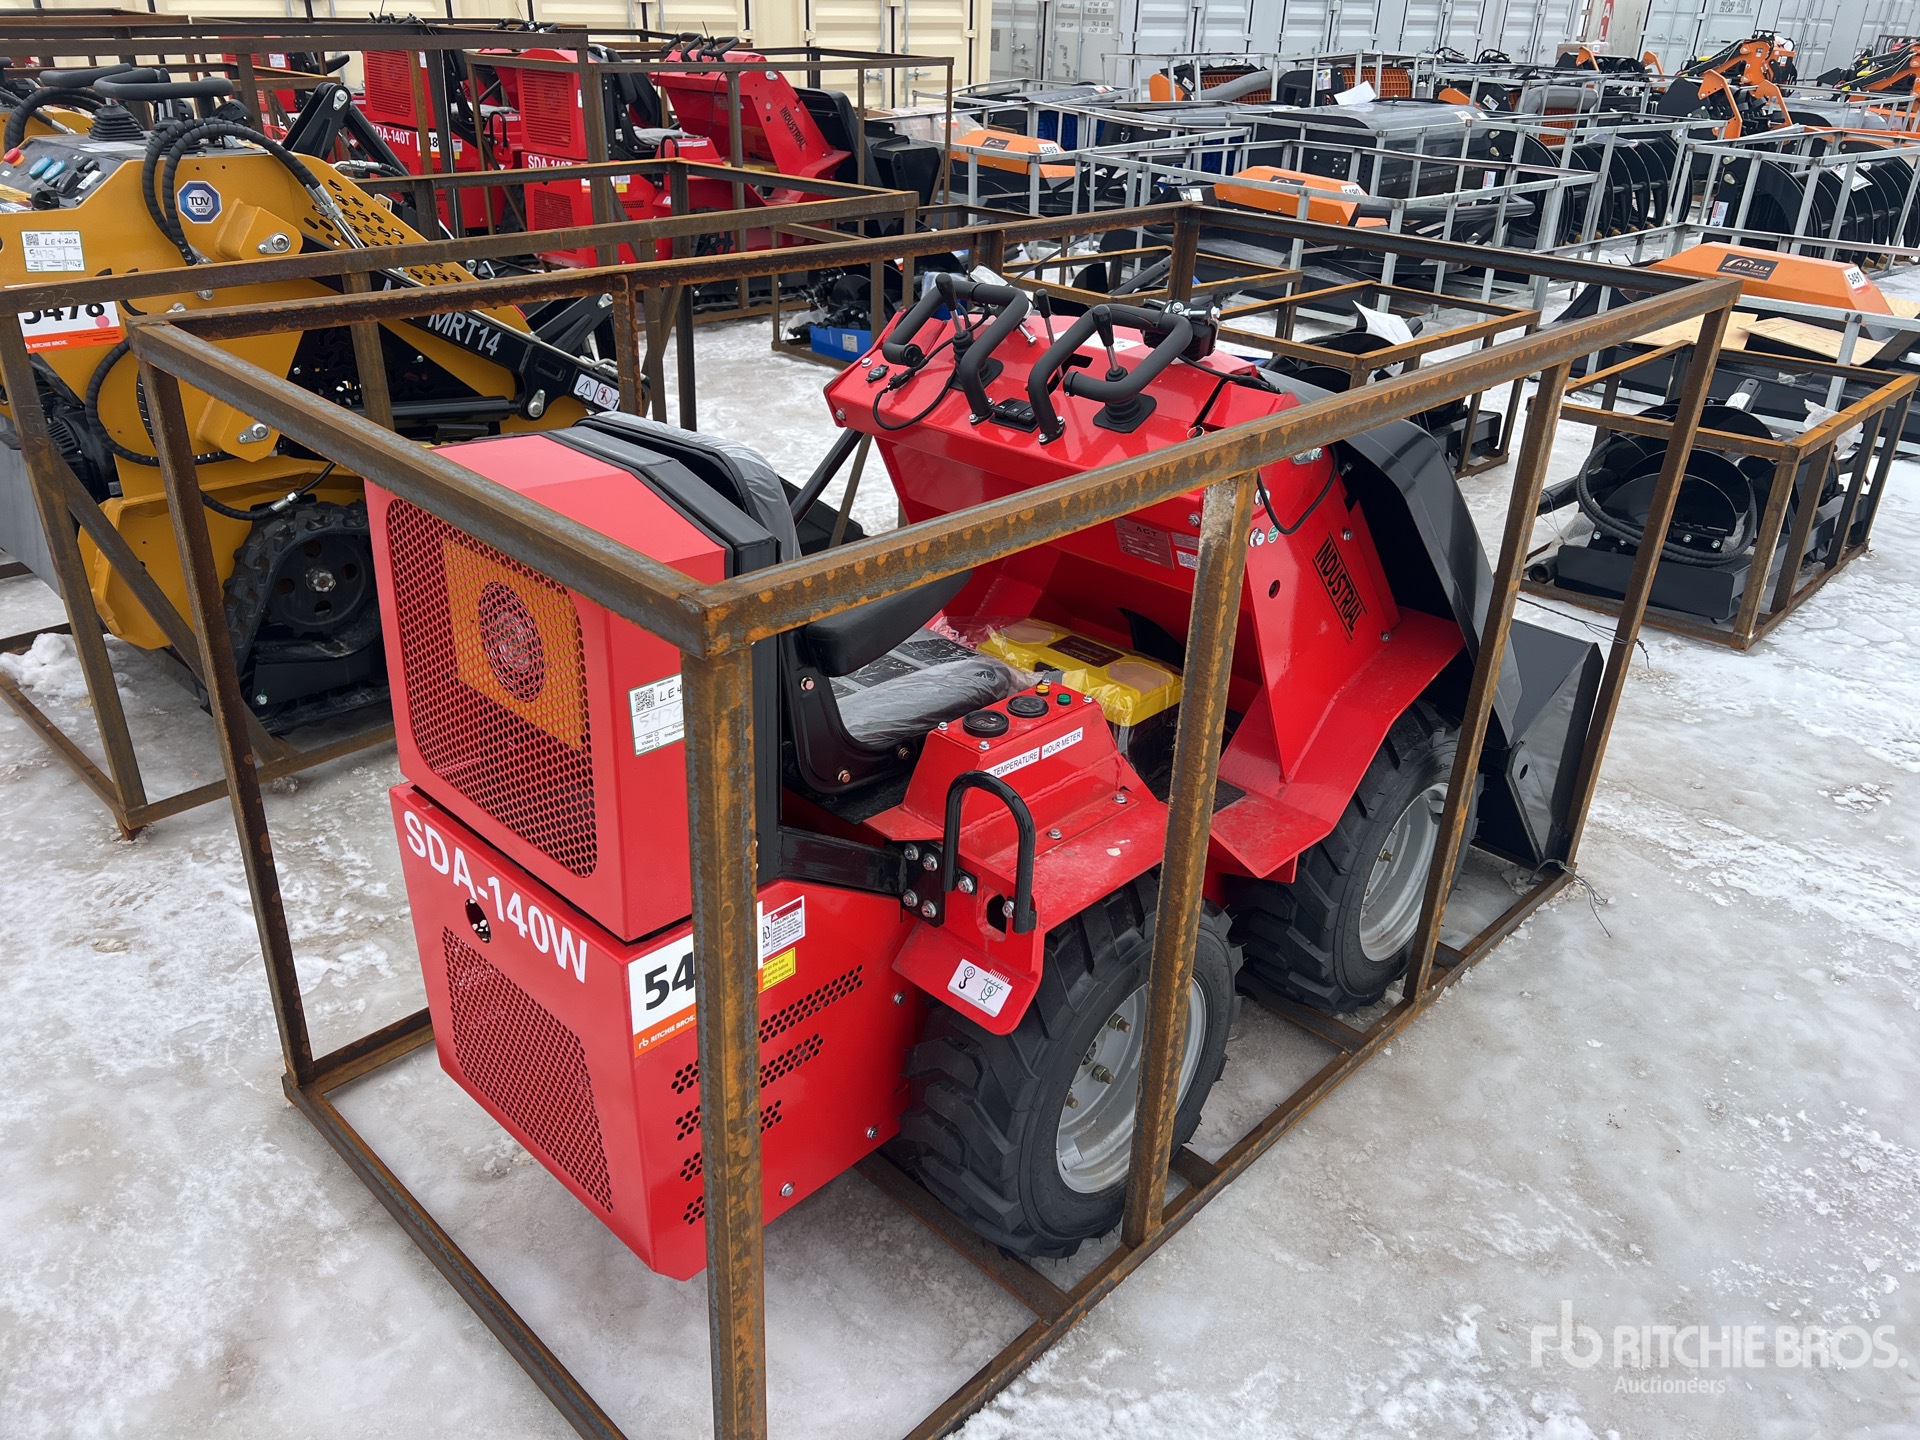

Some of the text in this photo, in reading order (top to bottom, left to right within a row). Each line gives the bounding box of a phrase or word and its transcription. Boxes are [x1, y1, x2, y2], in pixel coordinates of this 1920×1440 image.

[780, 106, 807, 148] INDUSTRIAL
[1848, 271, 1863, 285] 5491
[427, 311, 502, 356] MRT14
[1314, 536, 1363, 632] INDUSTRIAL
[1043, 730, 1081, 757] HOUR METER
[993, 751, 1038, 777] TEMPERATURE
[403, 810, 588, 984] SDA-140W
[774, 910, 800, 926] FILLING FUEL
[650, 1023, 676, 1043] RITCHIE
[675, 1014, 696, 1029] BROS.
